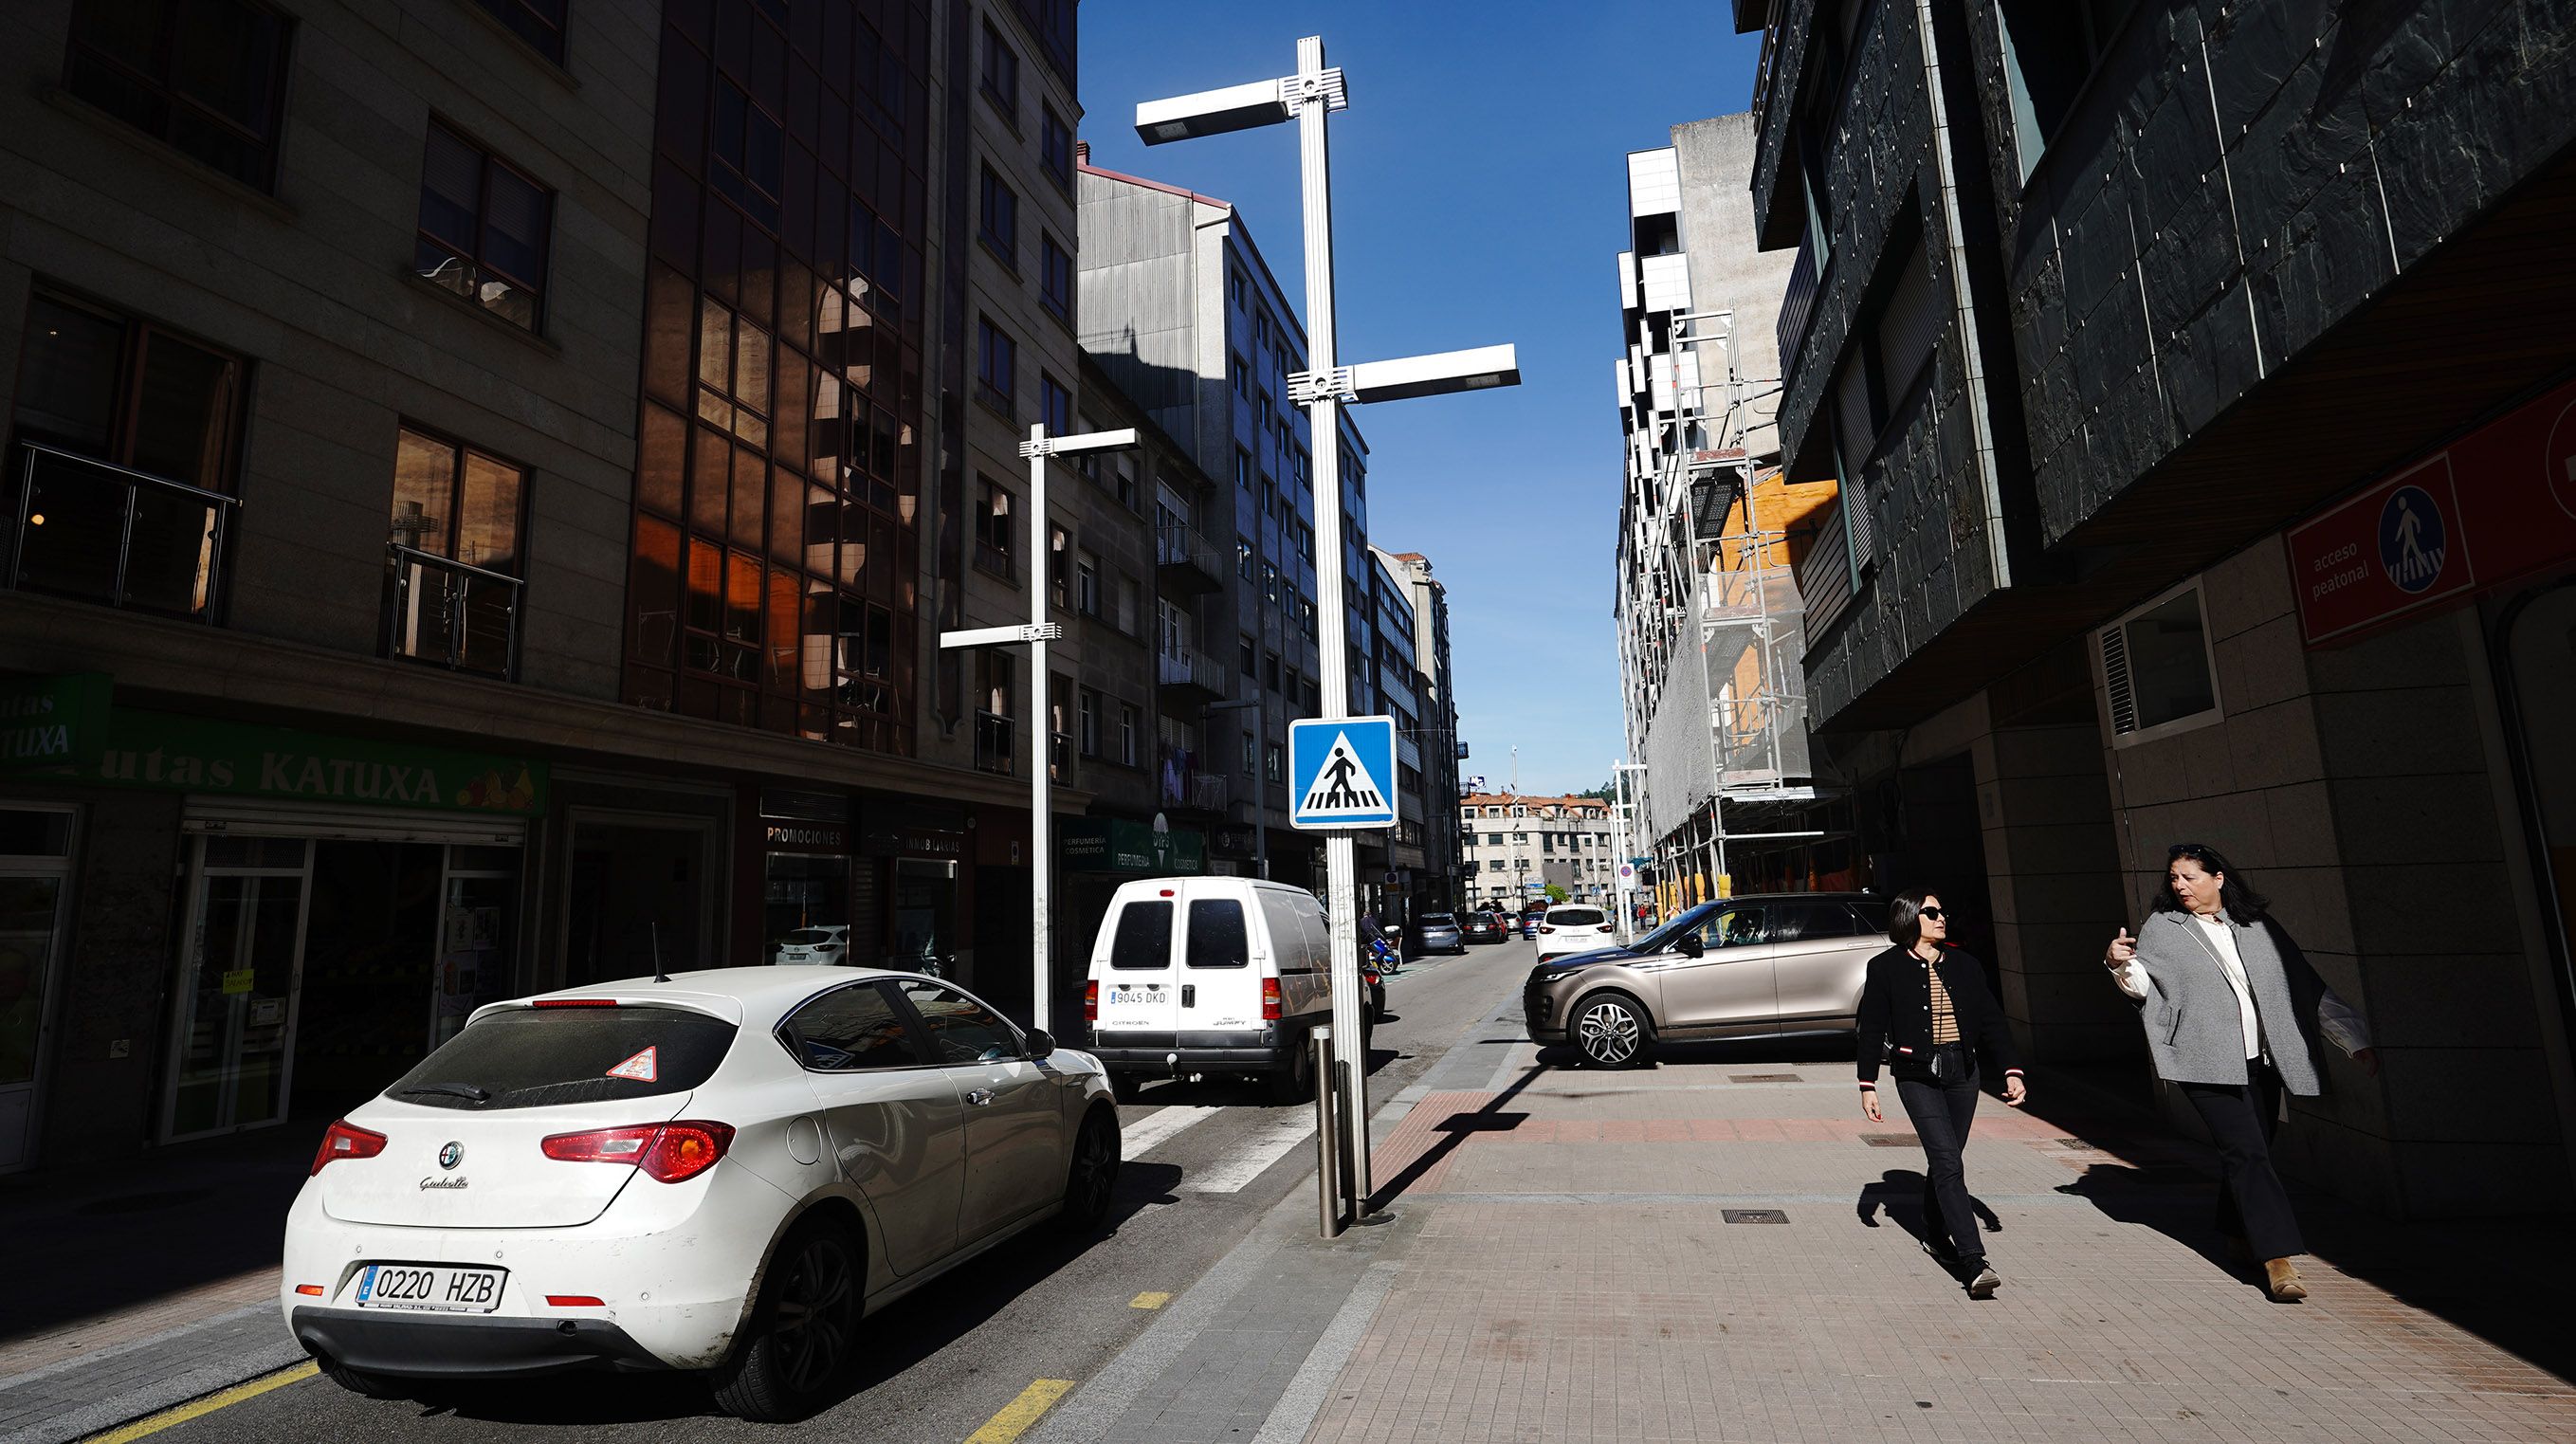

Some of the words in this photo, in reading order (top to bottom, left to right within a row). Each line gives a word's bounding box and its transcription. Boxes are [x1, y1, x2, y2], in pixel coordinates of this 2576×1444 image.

[2313, 542, 2357, 572] acceso
[2311, 560, 2370, 602] peatonal
[55, 745, 236, 788] utas
[259, 752, 440, 804] KATUXA
[767, 827, 841, 847] PROMOCIONES
[905, 834, 959, 853] INMOBLIARIAS
[1063, 835, 1106, 846] PERFUMERÍA
[1117, 993, 1142, 1003] 9045
[1145, 993, 1166, 1003] DKD
[419, 1177, 468, 1192] Giulietta
[376, 1269, 434, 1300] 0220
[446, 1271, 495, 1303] HZB
